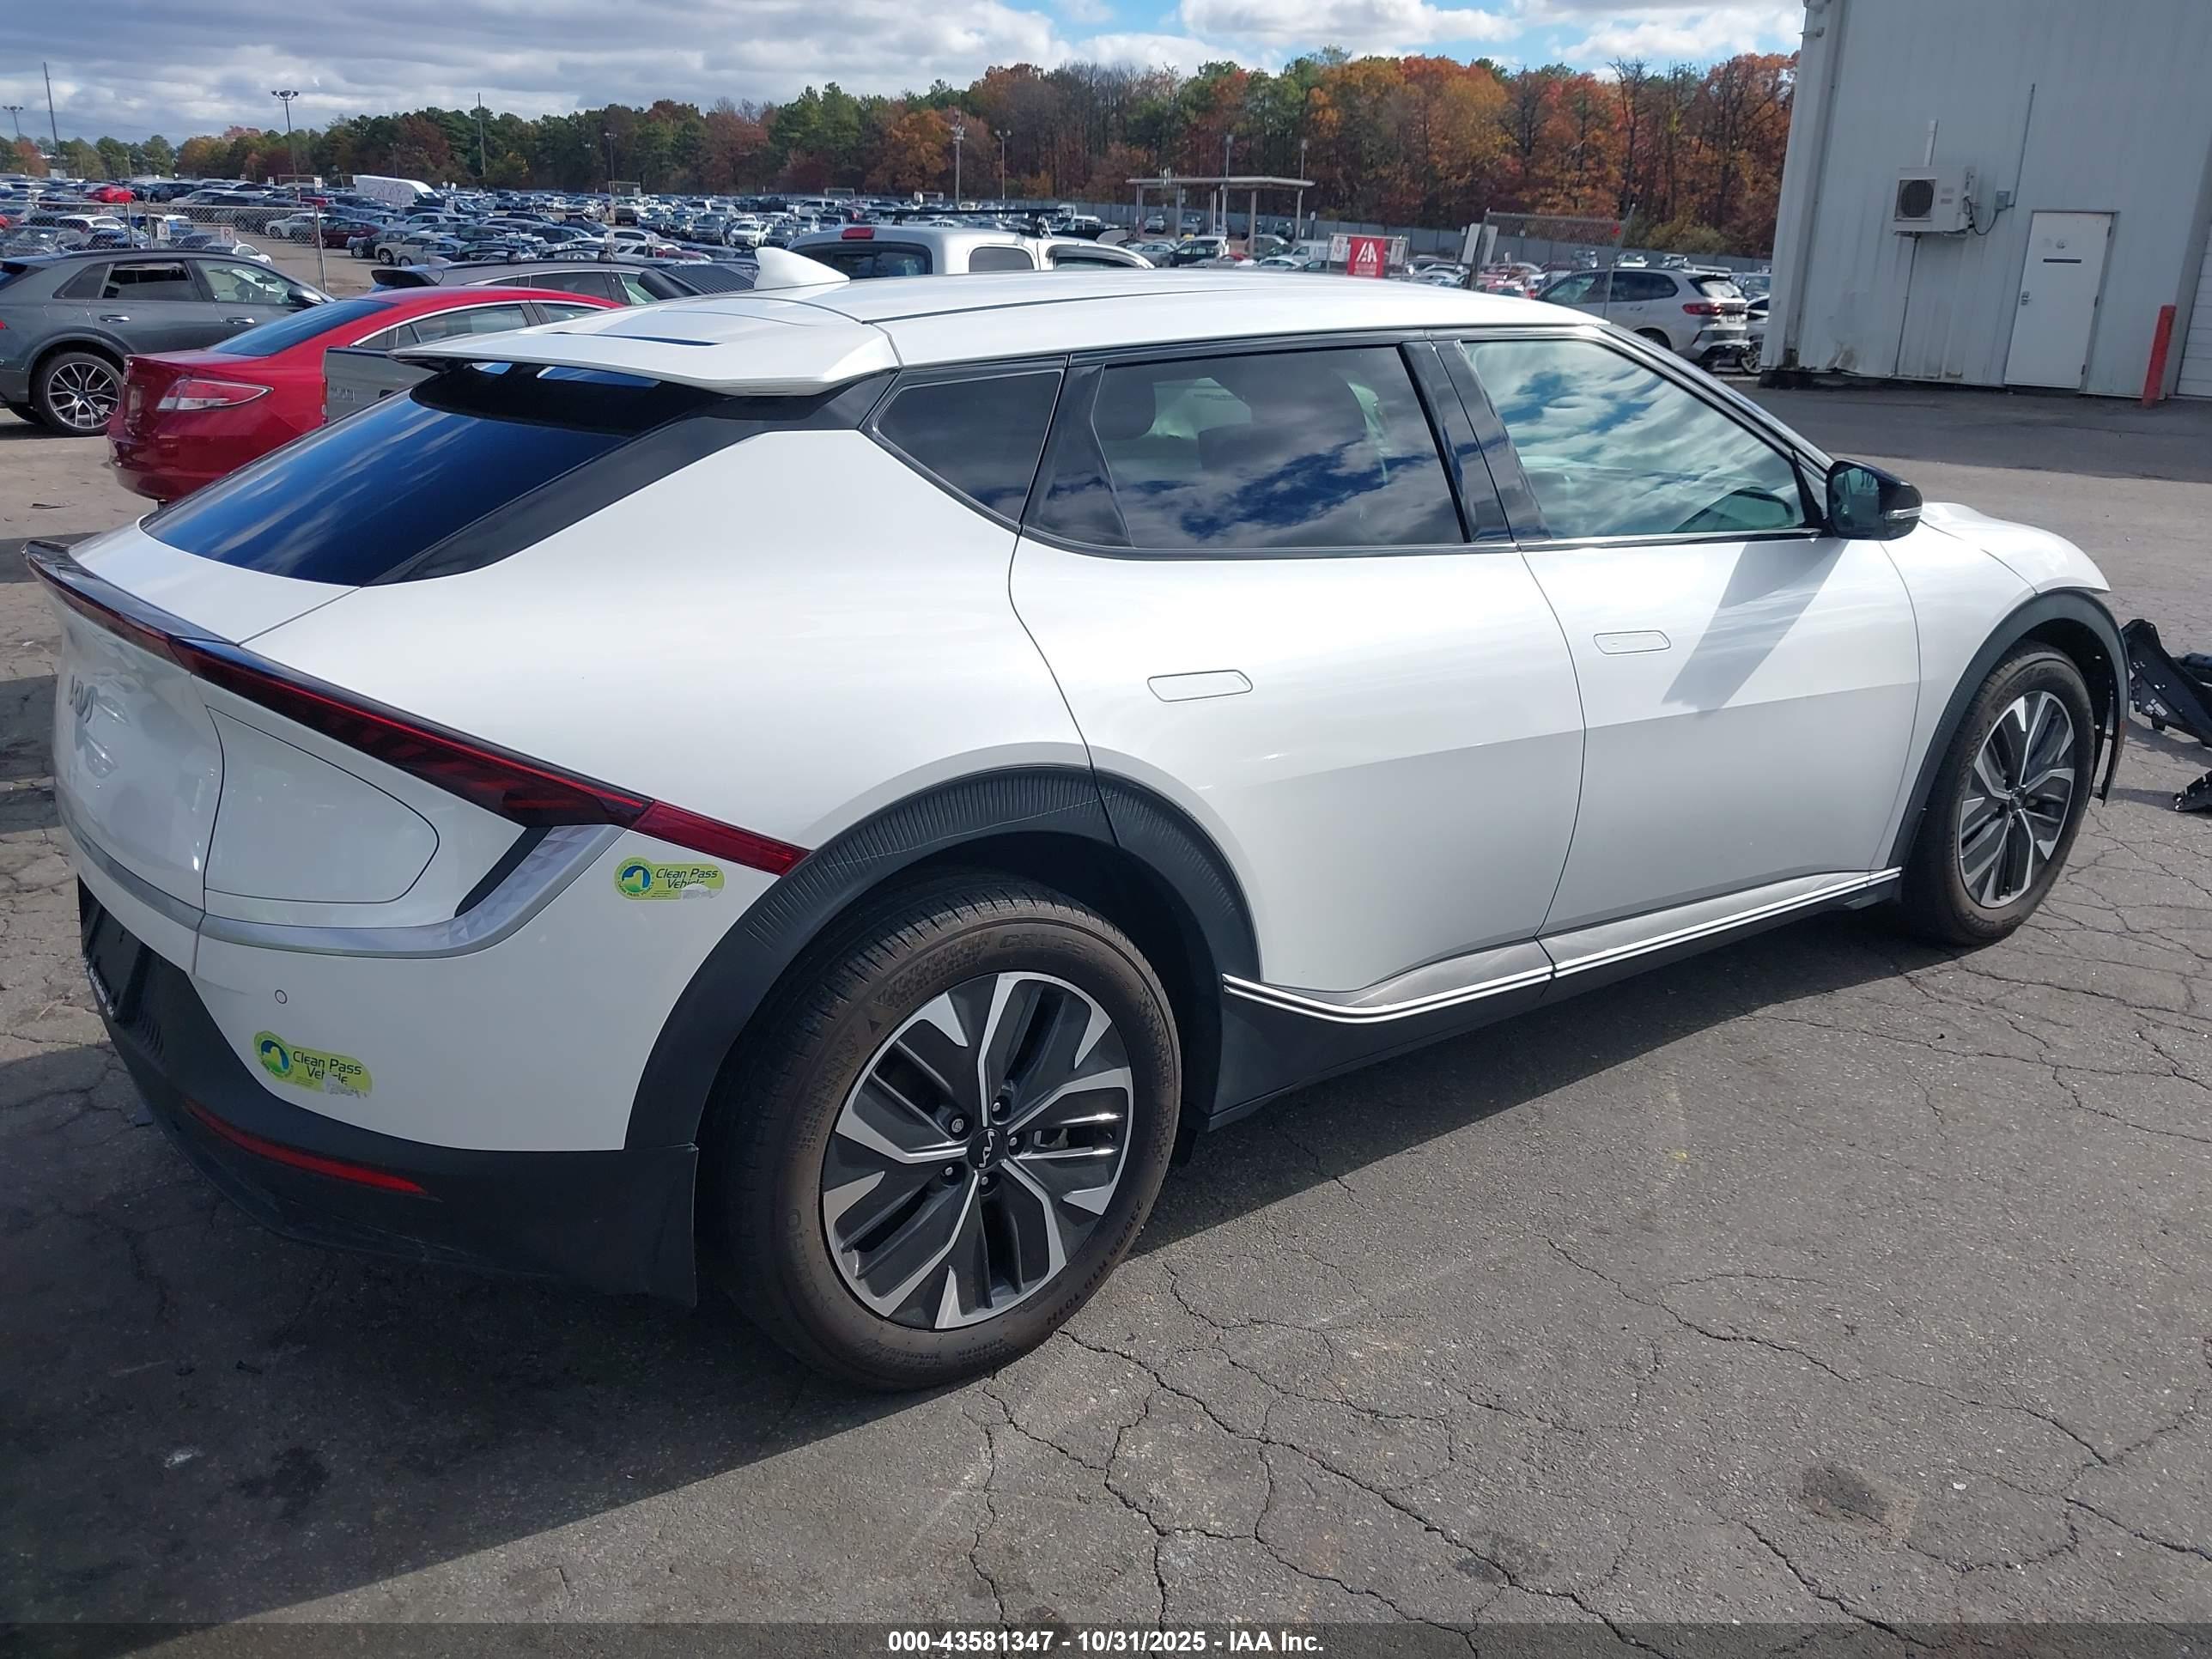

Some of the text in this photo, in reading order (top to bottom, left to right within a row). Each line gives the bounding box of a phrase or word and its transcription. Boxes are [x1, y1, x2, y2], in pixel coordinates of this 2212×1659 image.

[223, 228, 232, 240] R
[1394, 242, 1404, 256] T
[656, 868, 687, 878] Clean
[690, 868, 719, 878] Pass
[294, 1051, 362, 1075] Clean Pass
[307, 1065, 349, 1085] Vehle
